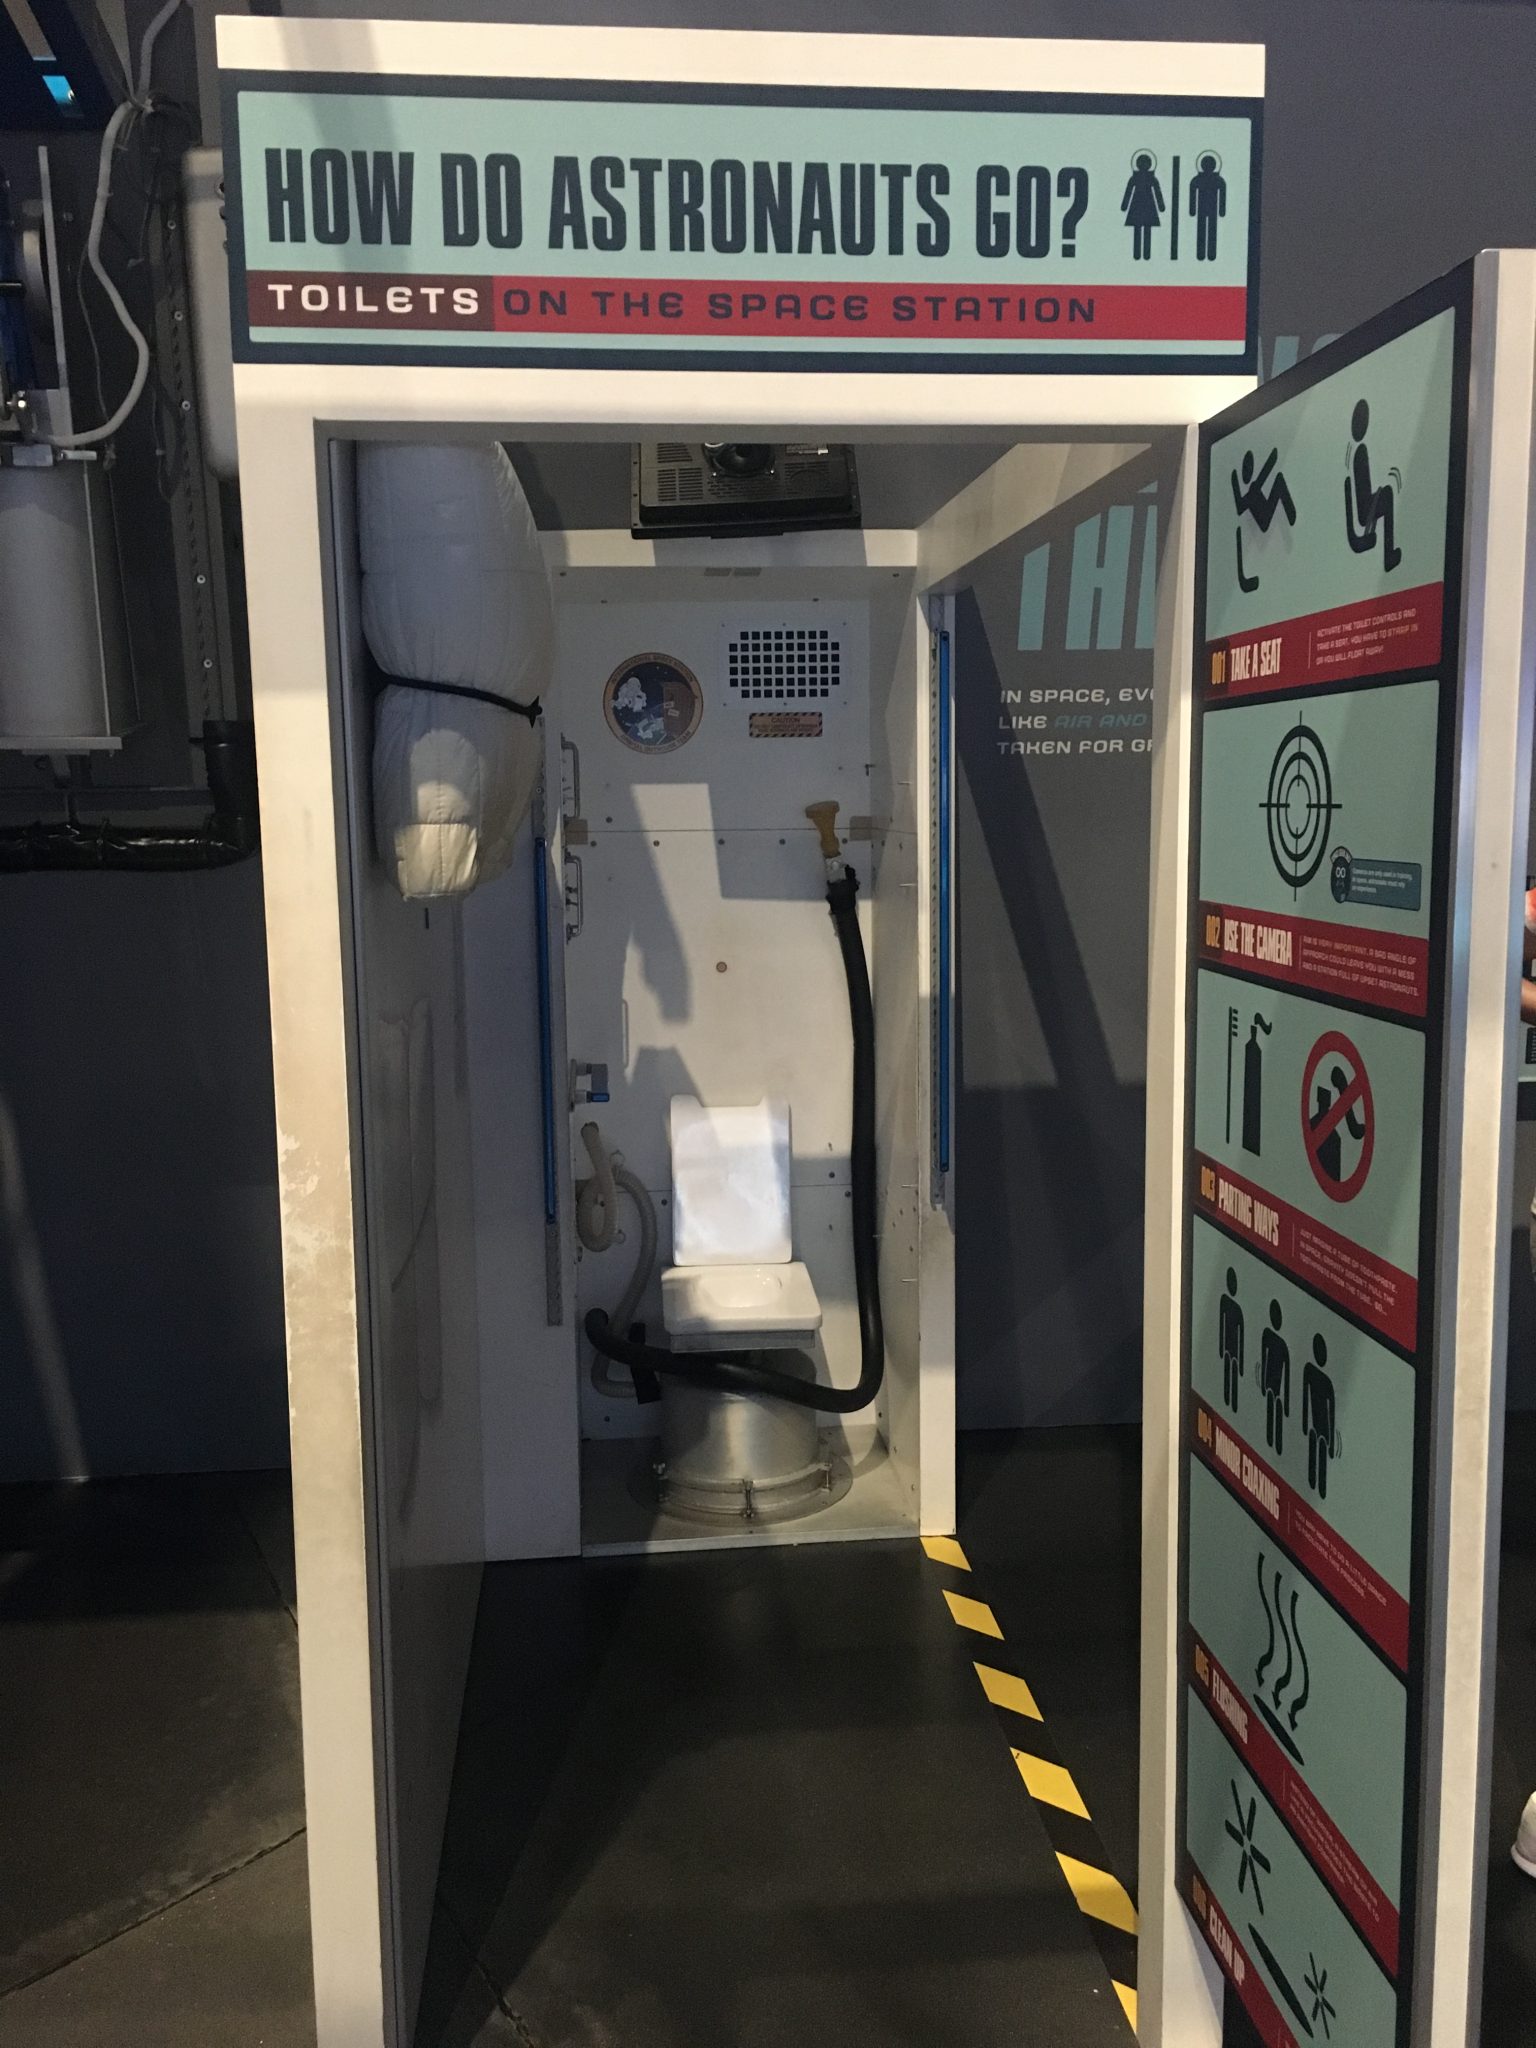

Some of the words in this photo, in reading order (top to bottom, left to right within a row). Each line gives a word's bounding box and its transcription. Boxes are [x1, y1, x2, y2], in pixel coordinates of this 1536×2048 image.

[265, 147, 414, 245] HOW
[440, 152, 524, 249] DO
[548, 155, 950, 257] ASTRONAUTS
[976, 165, 1089, 258] GO?
[268, 283, 479, 315] TOILETS
[503, 288, 567, 316] ON
[592, 291, 684, 319] THE
[707, 293, 868, 320] SPACE
[892, 295, 1096, 323] STATION
[1317, 625, 1341, 637] ACTIVATE
[1342, 623, 1352, 632] THE
[1353, 618, 1371, 629] TOILET
[1372, 611, 1402, 625] CONTROLS
[1403, 608, 1416, 618] AND
[1317, 642, 1329, 651] TAKE
[1331, 641, 1334, 649] A
[1351, 635, 1362, 644] YOU
[1363, 631, 1378, 642] HAVE
[1379, 629, 1386, 638] TO
[1411, 623, 1418, 632] IN
[1212, 651, 1226, 685] 001
[1231, 645, 1250, 682] TAKE
[1252, 644, 1258, 677] A
[1260, 638, 1282, 677] SEAT
[1316, 657, 1323, 665] OR
[1324, 655, 1334, 664] YOU
[1335, 652, 1346, 661] WILL
[1348, 649, 1364, 659] FLOAT
[1001, 689, 1022, 703] IN
[1029, 688, 1111, 706] SPACE,
[1118, 688, 1153, 702] EV
[999, 715, 1048, 729] LIKE
[1054, 714, 1093, 729] AIR
[1099, 713, 1148, 728] AND
[997, 741, 1071, 755] TAKEN
[1079, 739, 1123, 754] FOR
[1206, 914, 1220, 948] 002
[1224, 919, 1238, 953] USE
[1241, 922, 1255, 957] THE
[1257, 925, 1292, 966] CAMERA
[1318, 939, 1332, 948] VERY
[1375, 950, 1386, 959] BAD
[1387, 953, 1406, 963] ANGLE
[1408, 957, 1416, 966] OF
[1302, 962, 1312, 970] AND
[1318, 965, 1337, 977] STATION
[1351, 973, 1359, 982] OF
[1329, 954, 1346, 965] COULD
[1347, 958, 1364, 969] LEAVE
[1365, 962, 1376, 972] YOU
[1377, 965, 1391, 975] WITH
[1392, 968, 1397, 976] A
[1398, 969, 1415, 980] MESS
[1219, 1178, 1252, 1229] PARTING
[1254, 1200, 1279, 1247] WAYS
[1216, 1425, 1240, 1479] MINOR
[1243, 1453, 1279, 1521] COAXING
[1210, 1902, 1232, 1971] CLEAN
[1234, 1946, 1244, 1991] UP
